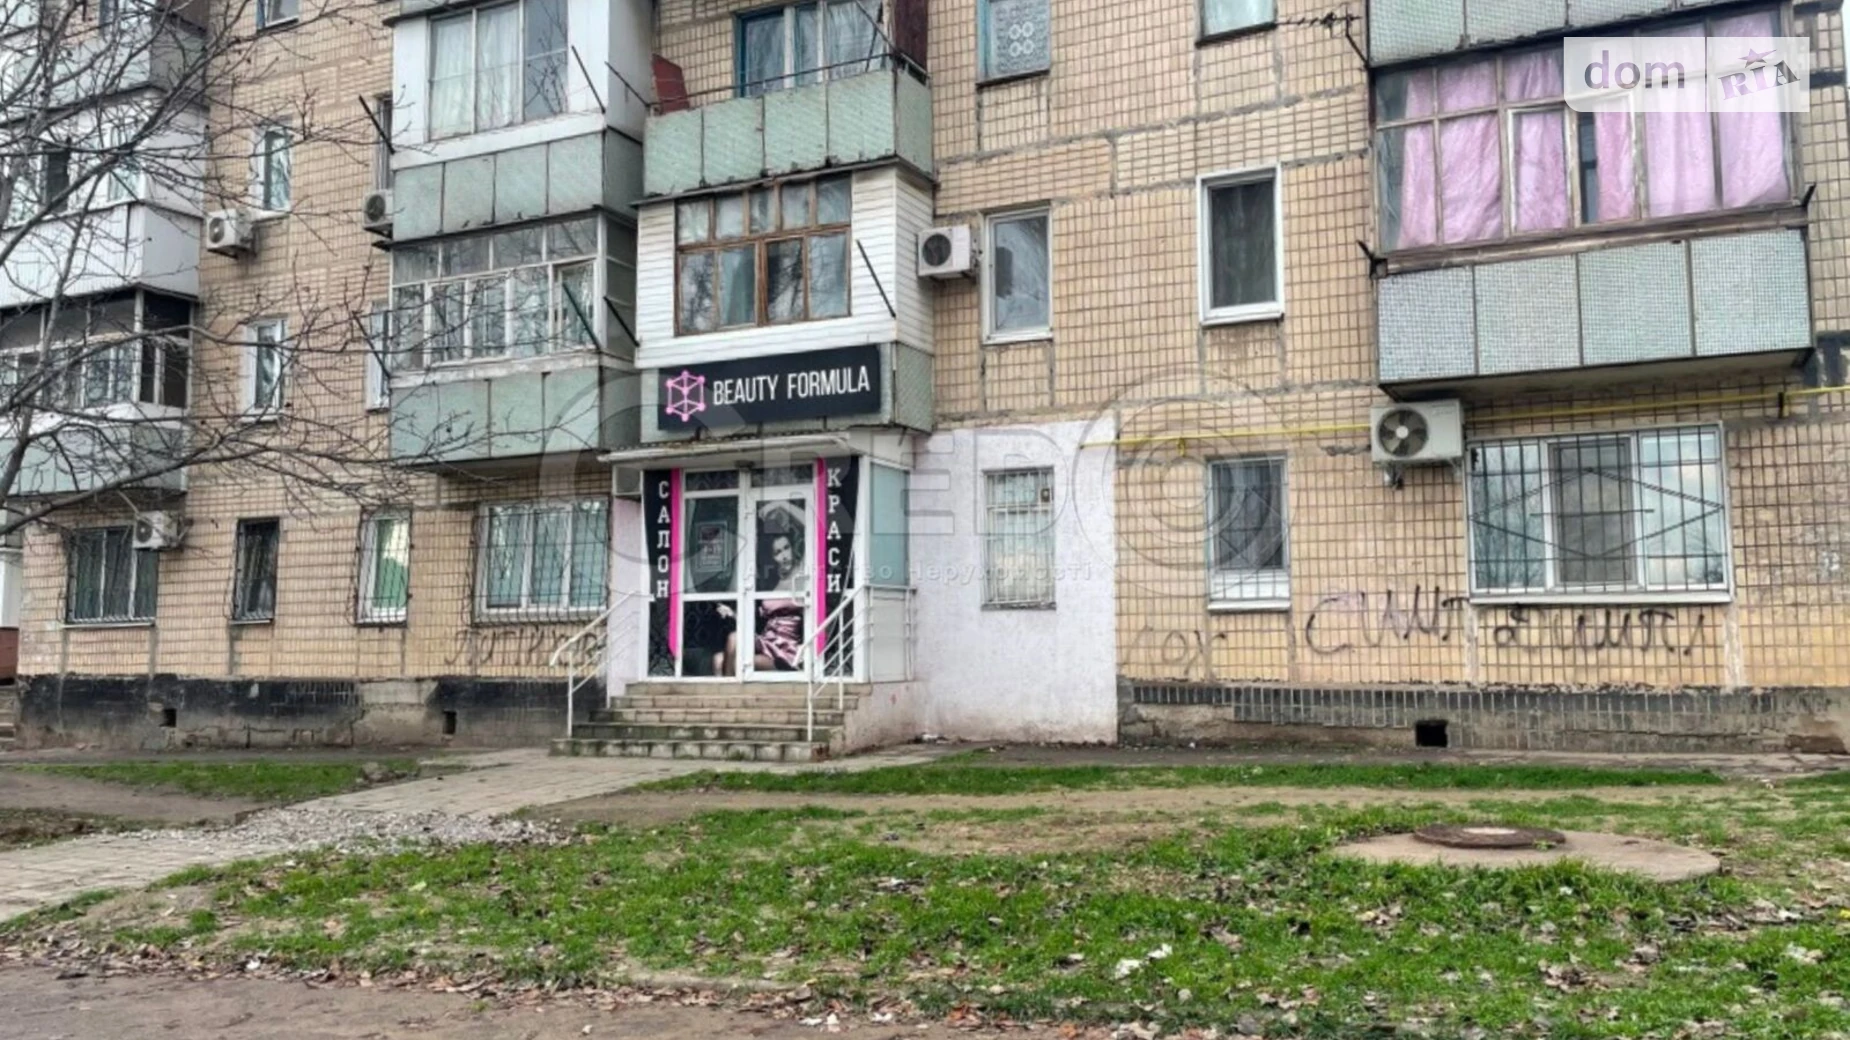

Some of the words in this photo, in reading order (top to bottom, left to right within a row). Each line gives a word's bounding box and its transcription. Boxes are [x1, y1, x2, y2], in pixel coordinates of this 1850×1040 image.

[713, 374, 779, 406] BEAUTY
[786, 365, 870, 400] FORMULA
[656, 480, 671, 598] САЛОН
[827, 468, 842, 593] КРАСИ
